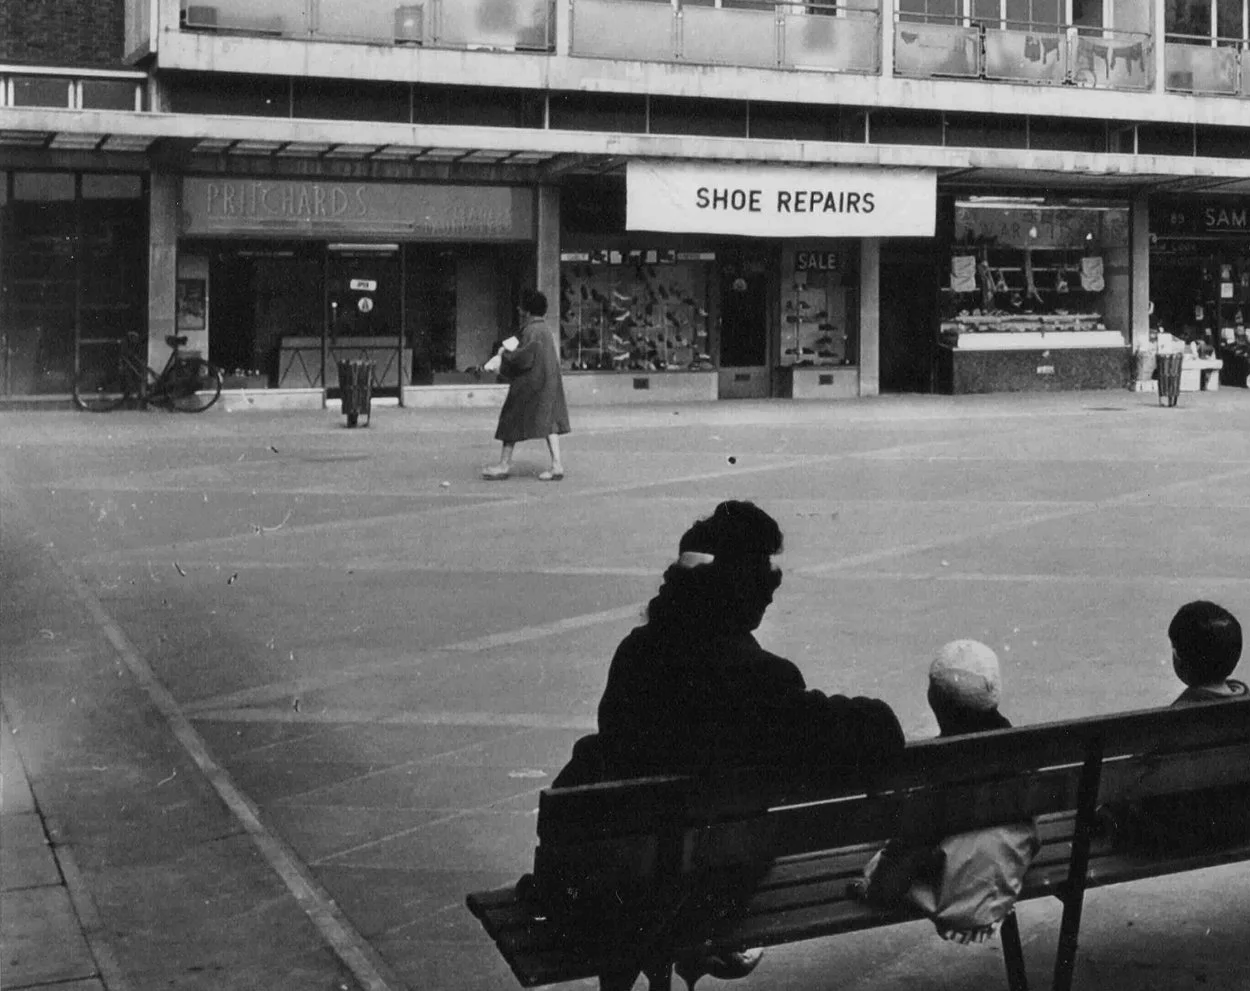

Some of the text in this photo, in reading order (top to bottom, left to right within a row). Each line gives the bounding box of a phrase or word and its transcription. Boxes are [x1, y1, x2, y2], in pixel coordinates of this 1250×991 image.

[207, 182, 367, 216] PRITCHARDS
[696, 187, 875, 213] SHOE REPAIRS
[1205, 208, 1247, 226] SAM
[799, 253, 836, 270] SALE
